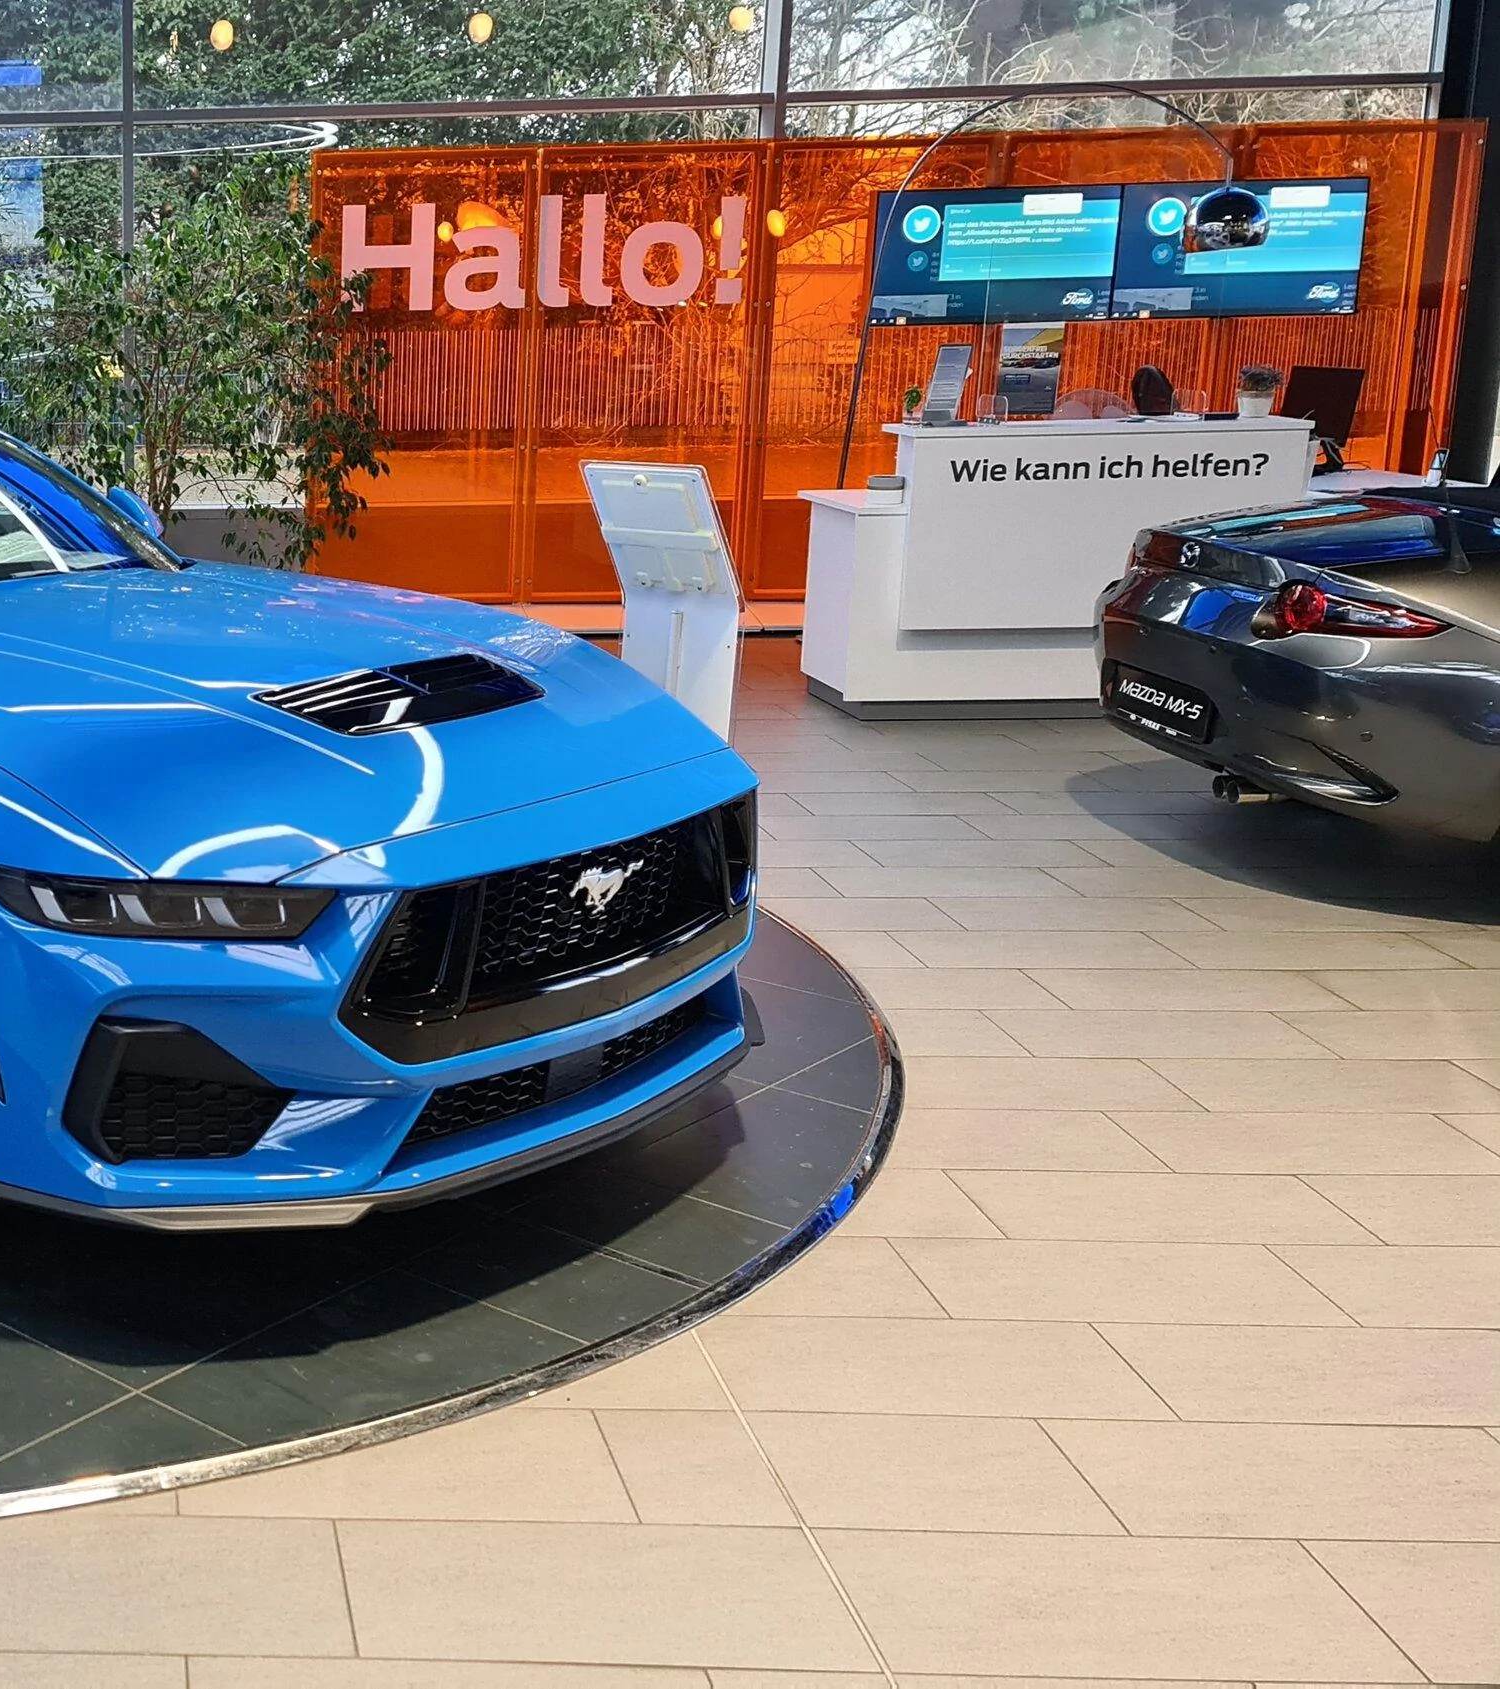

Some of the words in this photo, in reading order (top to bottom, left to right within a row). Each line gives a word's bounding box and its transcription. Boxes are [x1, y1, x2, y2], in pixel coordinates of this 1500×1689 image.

[341, 193, 746, 312] Hallo!
[1061, 292, 1094, 305] Ford
[1307, 285, 1341, 299] Ford
[950, 458, 1007, 483] Wie
[1015, 458, 1091, 481] kann
[1099, 454, 1143, 479] ich
[1152, 452, 1270, 478] helfen?
[1165, 696, 1203, 719] MX-5
